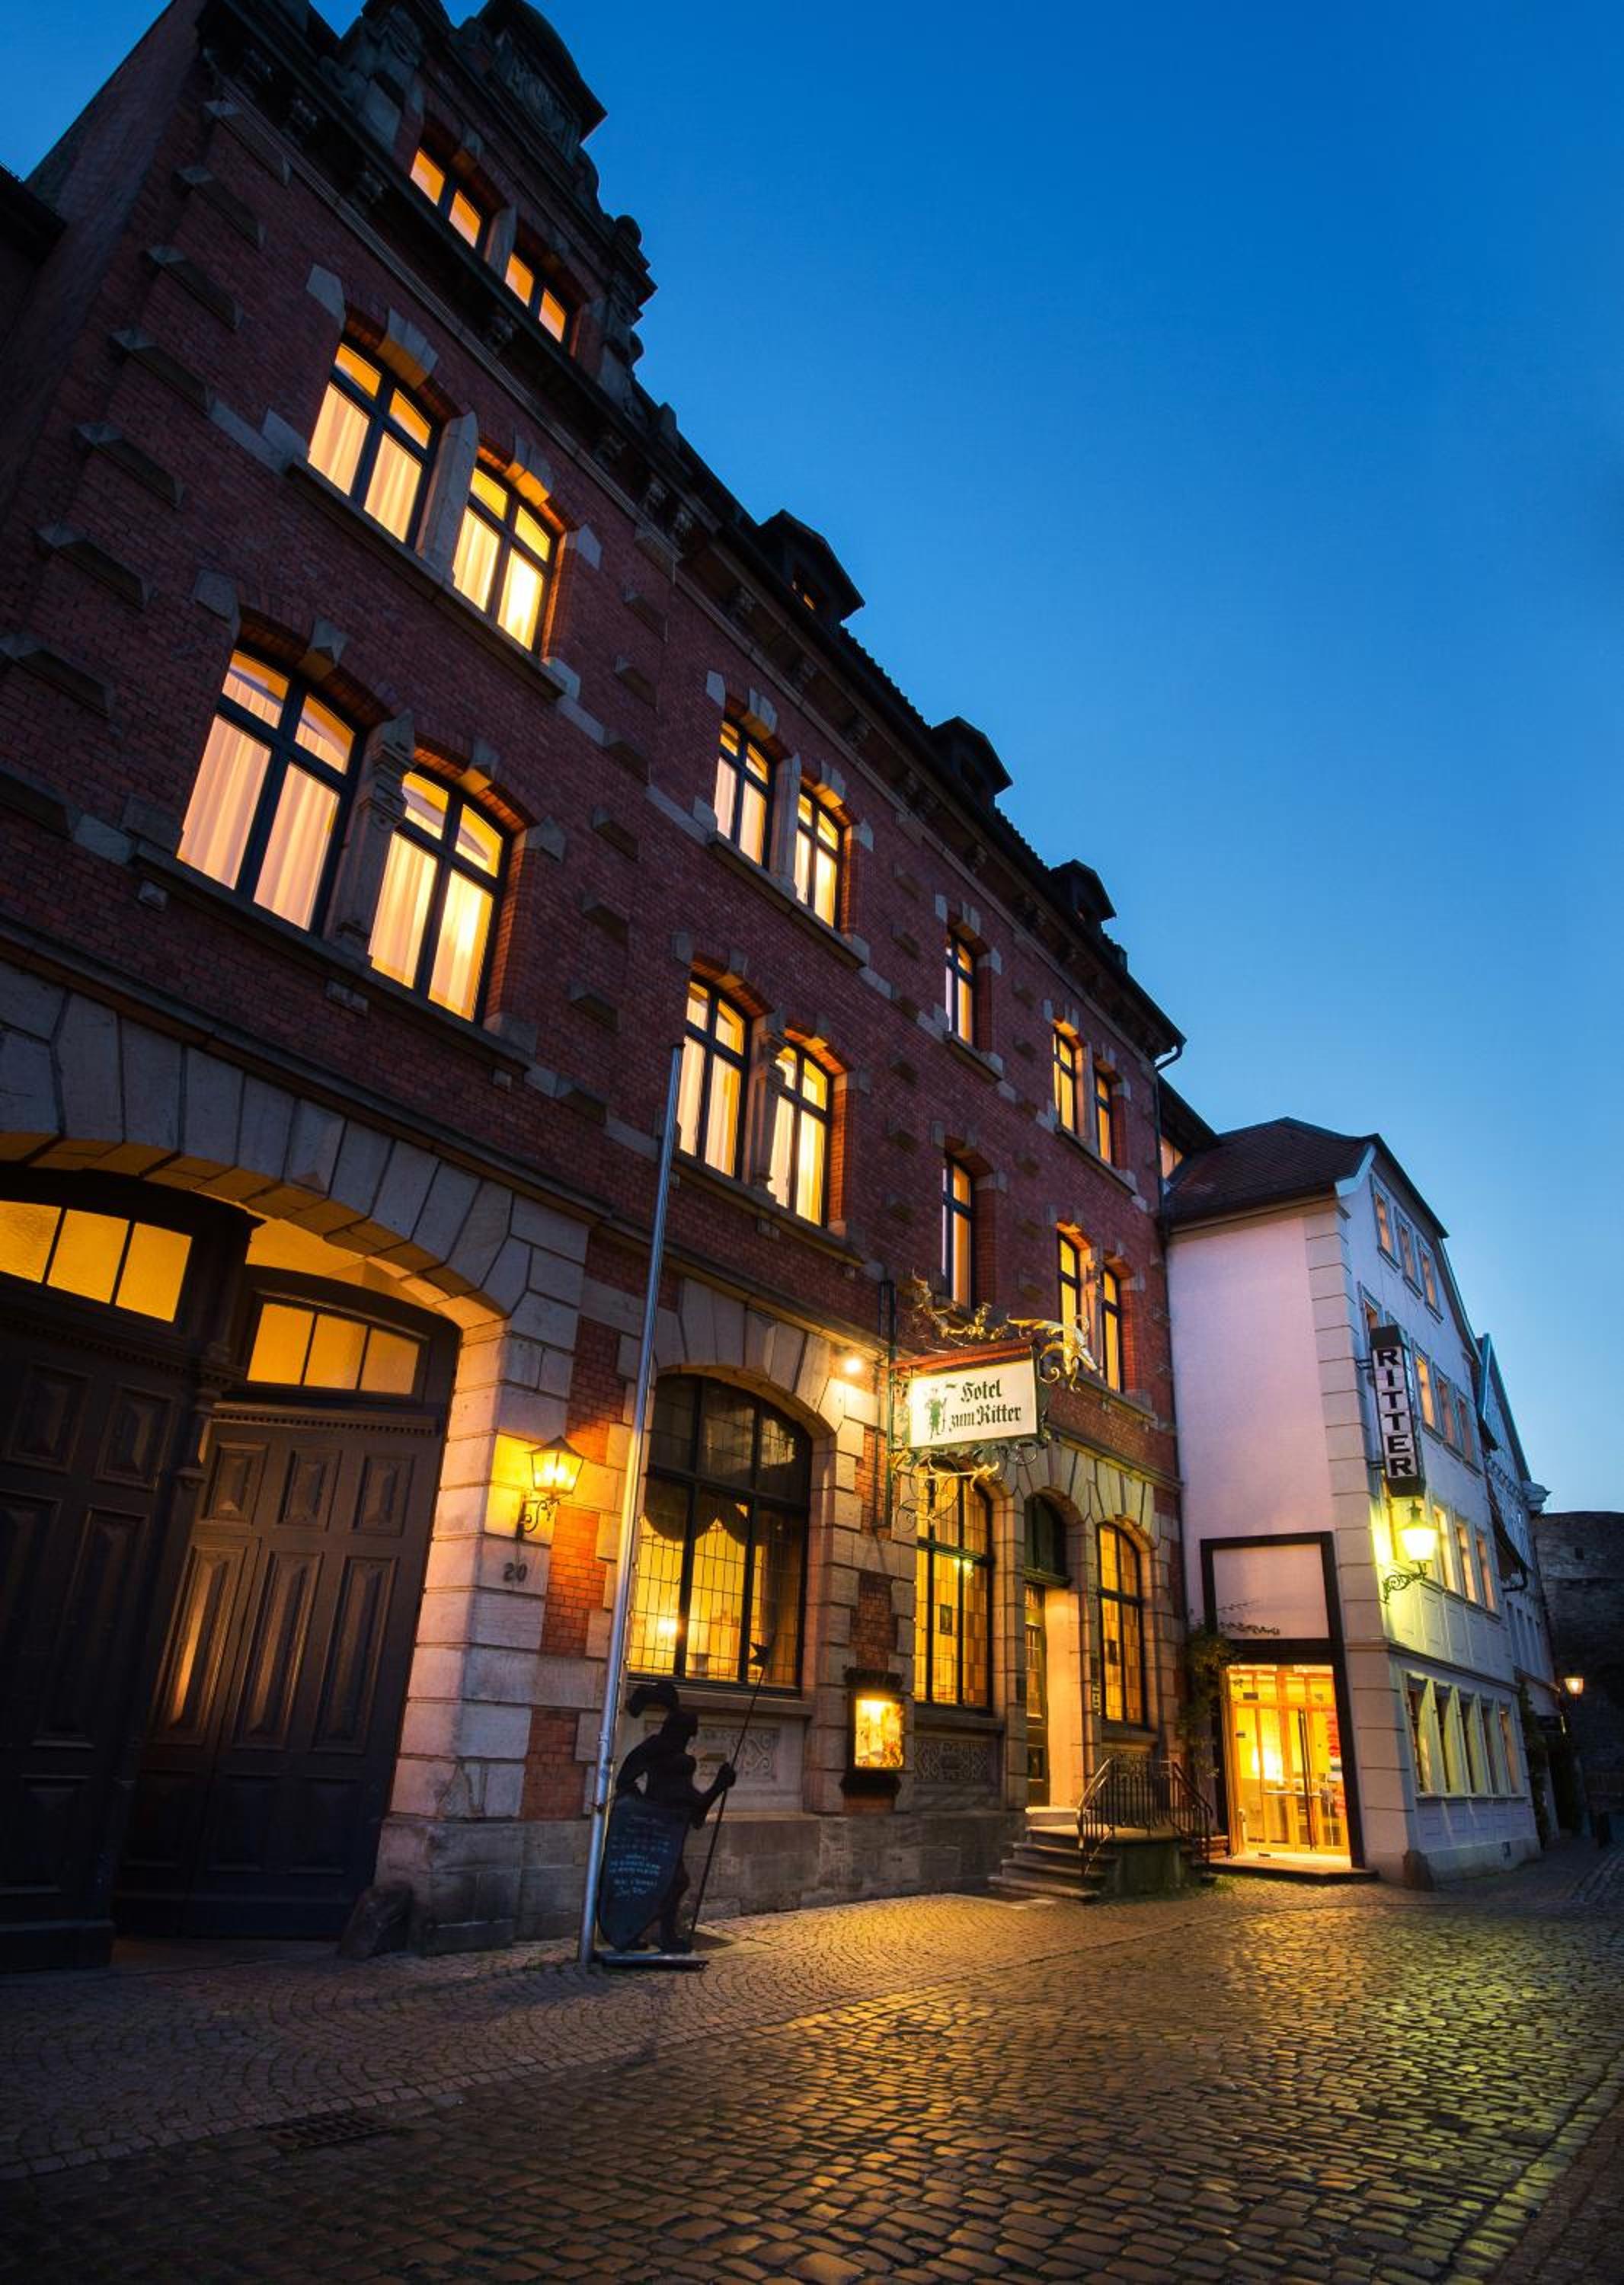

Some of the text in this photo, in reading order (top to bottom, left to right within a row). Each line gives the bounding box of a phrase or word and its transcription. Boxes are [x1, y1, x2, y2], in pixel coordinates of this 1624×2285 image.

[961, 1379, 1002, 1402] Hotel
[949, 1404, 1021, 1432] zum Ritter
[1376, 1347, 1413, 1476] RITTER
[503, 1562, 527, 1583] 20
